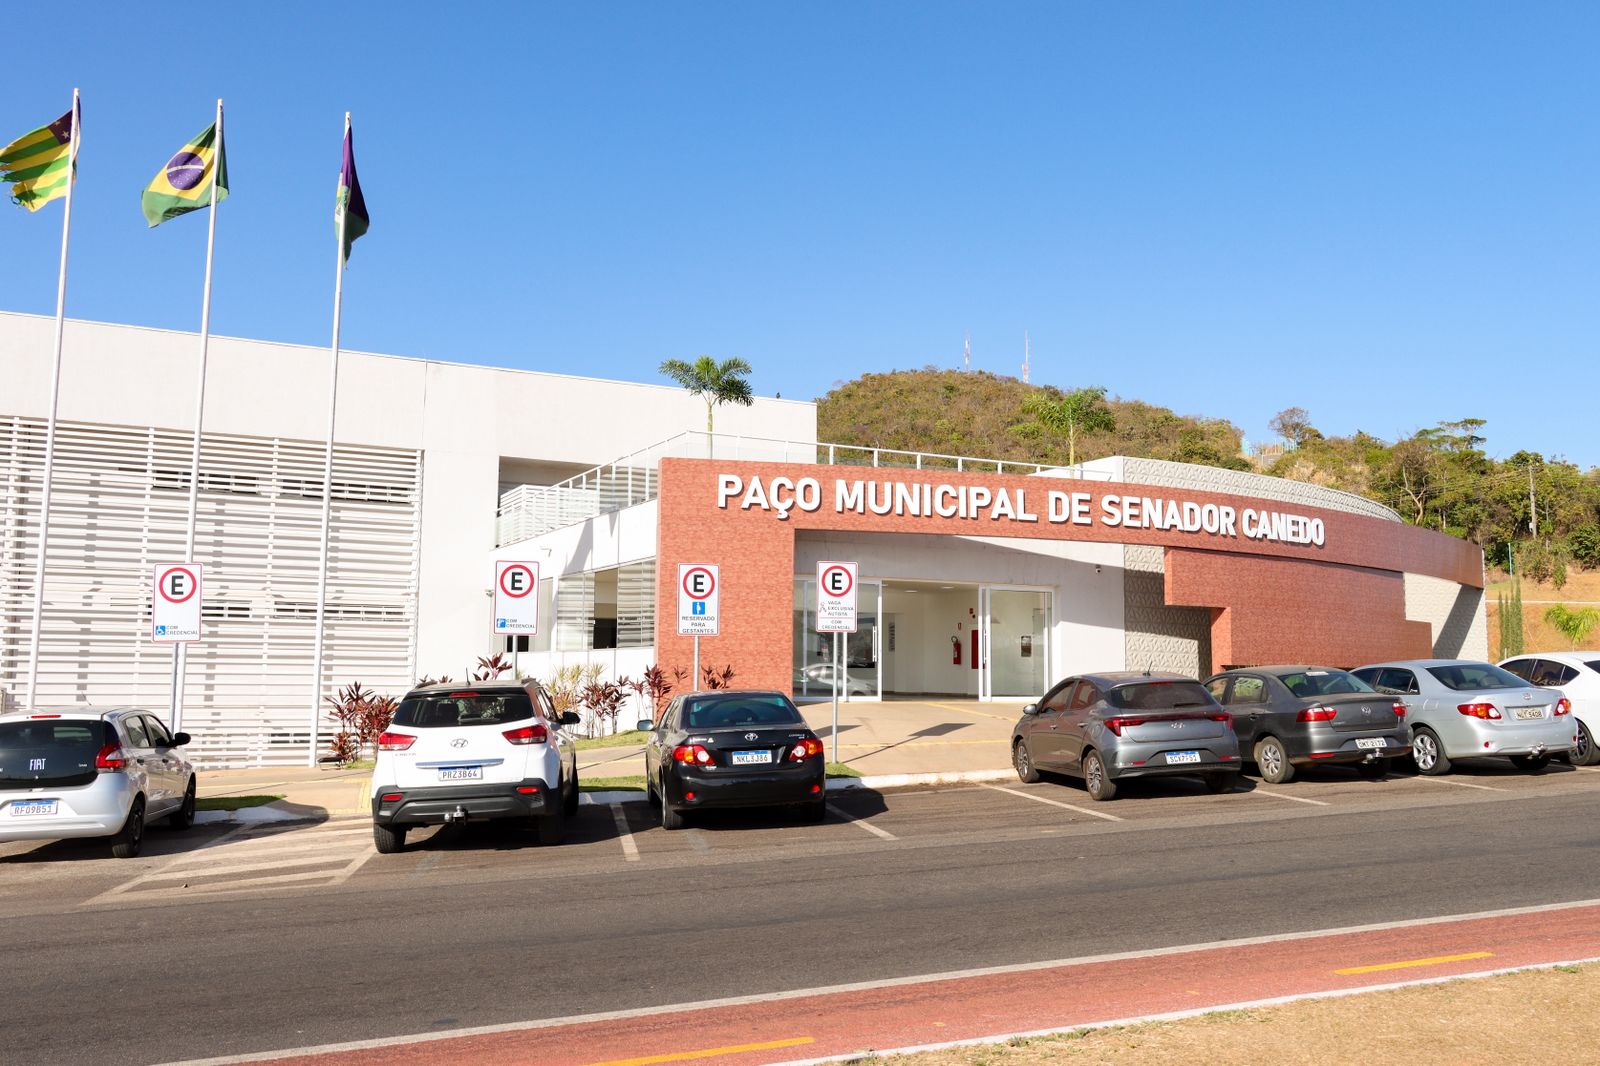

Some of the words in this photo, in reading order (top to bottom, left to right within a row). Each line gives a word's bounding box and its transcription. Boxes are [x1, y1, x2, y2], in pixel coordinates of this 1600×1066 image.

[718, 474, 821, 519] PAÇO
[835, 479, 1038, 522] MUNICIPAL
[1050, 490, 1092, 525] DE
[1101, 494, 1237, 537] SENADOR
[1241, 508, 1326, 547] CANEDO
[171, 575, 184, 595] E
[511, 572, 523, 591] E
[693, 574, 704, 592] E
[832, 572, 842, 590] E
[29, 758, 47, 771] FIAT
[442, 769, 478, 779] PRZ3B64
